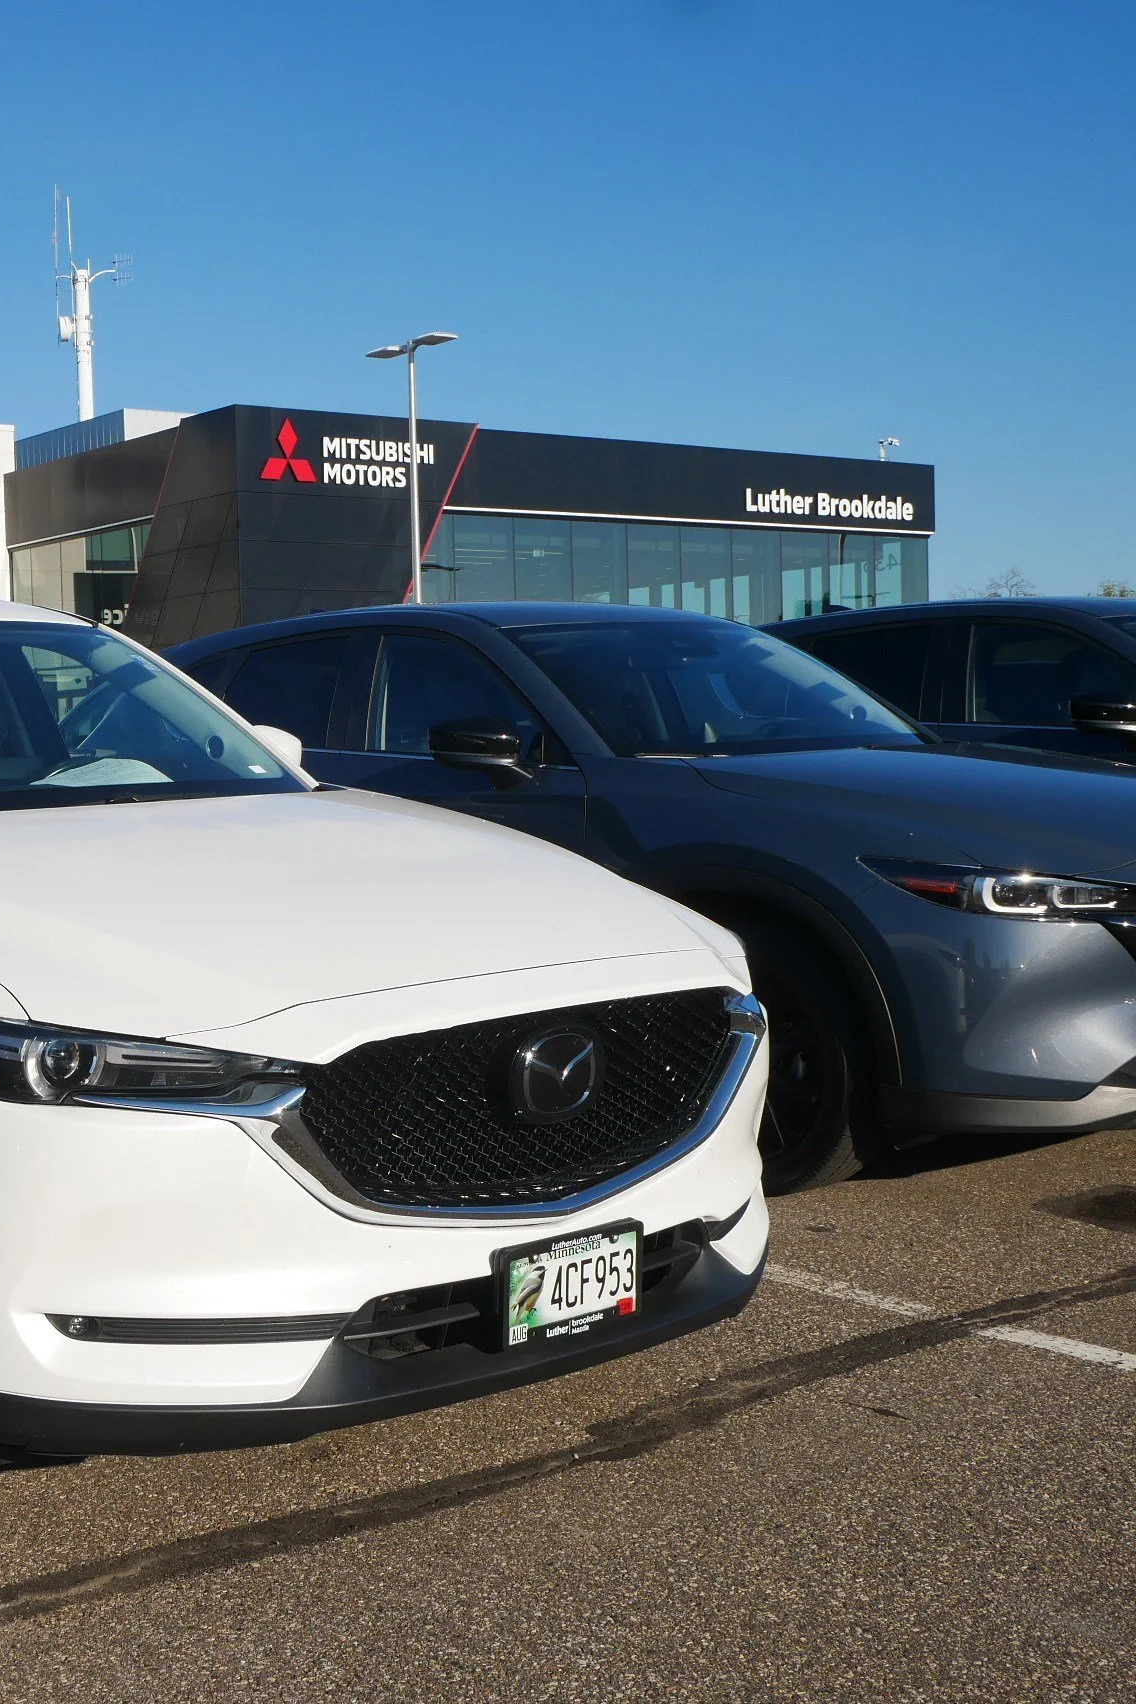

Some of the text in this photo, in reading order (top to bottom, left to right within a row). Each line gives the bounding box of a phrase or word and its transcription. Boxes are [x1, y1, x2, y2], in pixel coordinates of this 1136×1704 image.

[322, 436, 434, 465] MITSUBISHI
[323, 462, 407, 488] MOTORS
[745, 487, 914, 521] Luther Brookdale
[546, 1240, 601, 1261] Minnesota
[551, 1233, 603, 1250] LutherAuto.com
[550, 1248, 634, 1311] 4CF953
[511, 1325, 527, 1343] AUG
[546, 1312, 604, 1338] Luther brookdale
